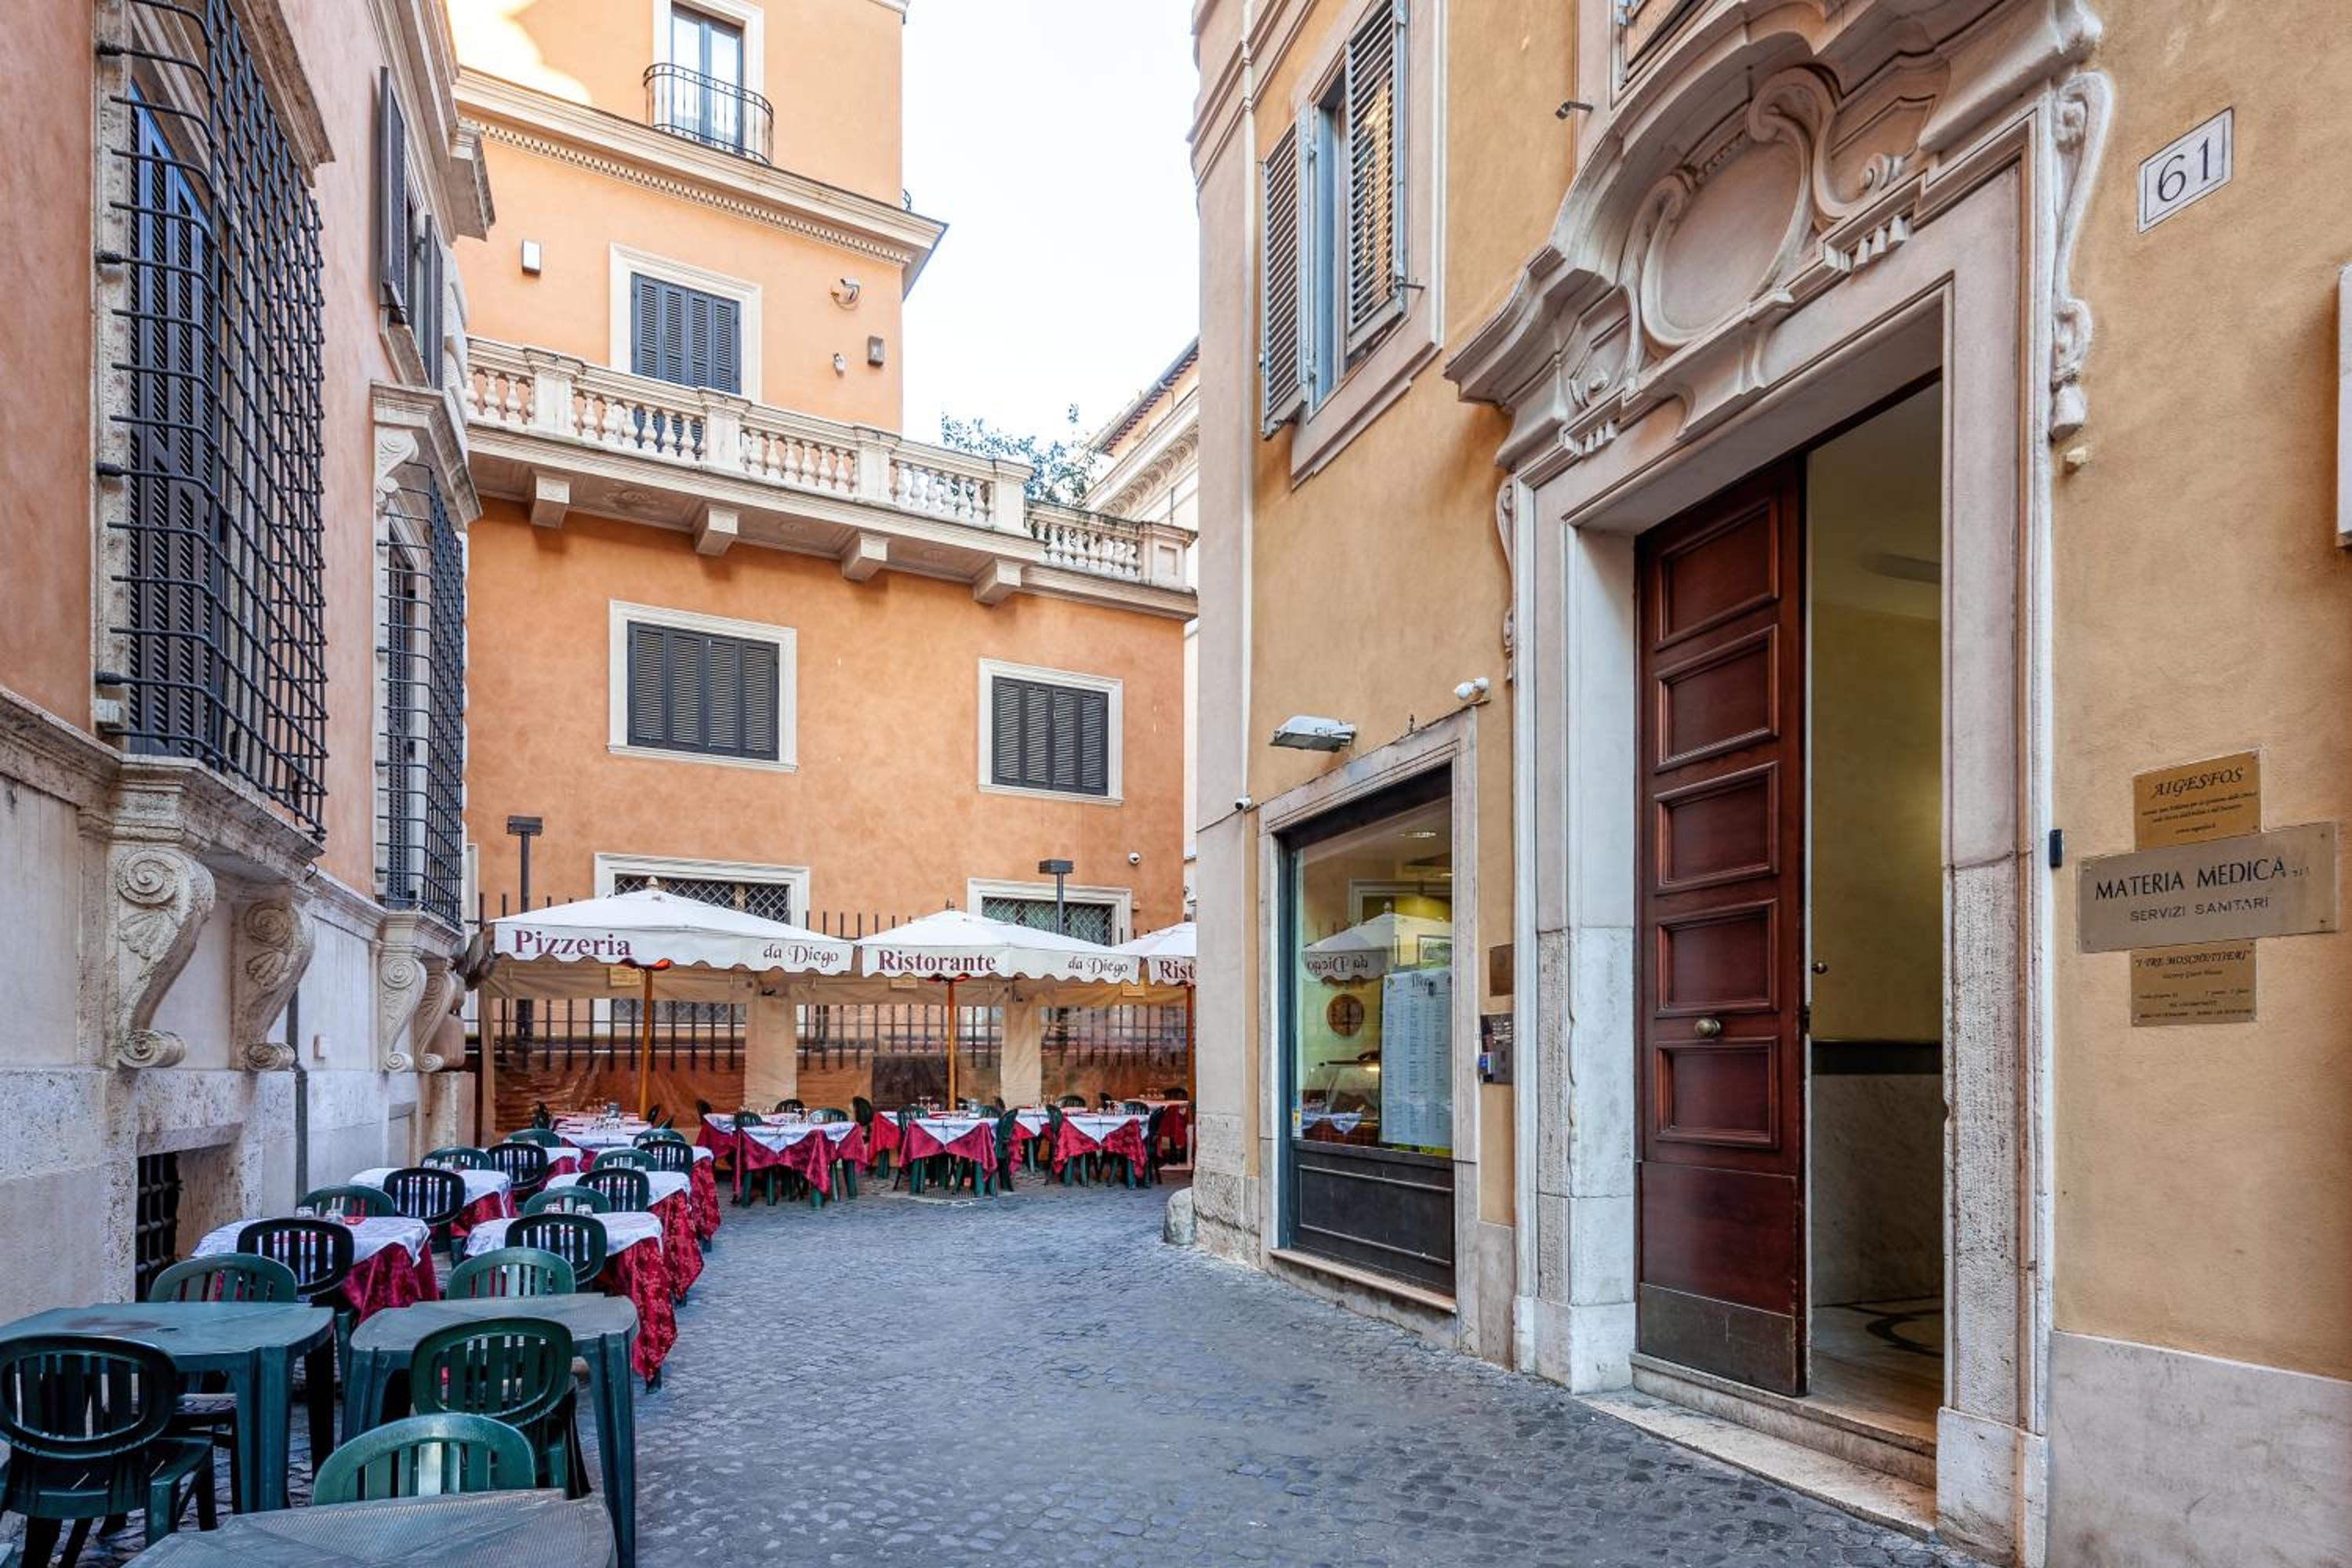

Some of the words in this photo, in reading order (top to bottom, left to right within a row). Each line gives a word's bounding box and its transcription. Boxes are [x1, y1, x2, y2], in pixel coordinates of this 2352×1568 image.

[2157, 136, 2210, 202] 61
[2095, 871, 2184, 901] MATERIA
[2197, 855, 2287, 888] MEDICA
[2129, 906, 2186, 922] SERVIZI
[2194, 896, 2269, 916] SANITARI
[514, 928, 633, 956] Pizzeria
[763, 942, 782, 960] da
[789, 943, 839, 967] Diego
[877, 948, 997, 972] Ristorante
[1066, 954, 1083, 972] da
[1086, 956, 1129, 978] Diego
[1159, 960, 1196, 979] Rist
